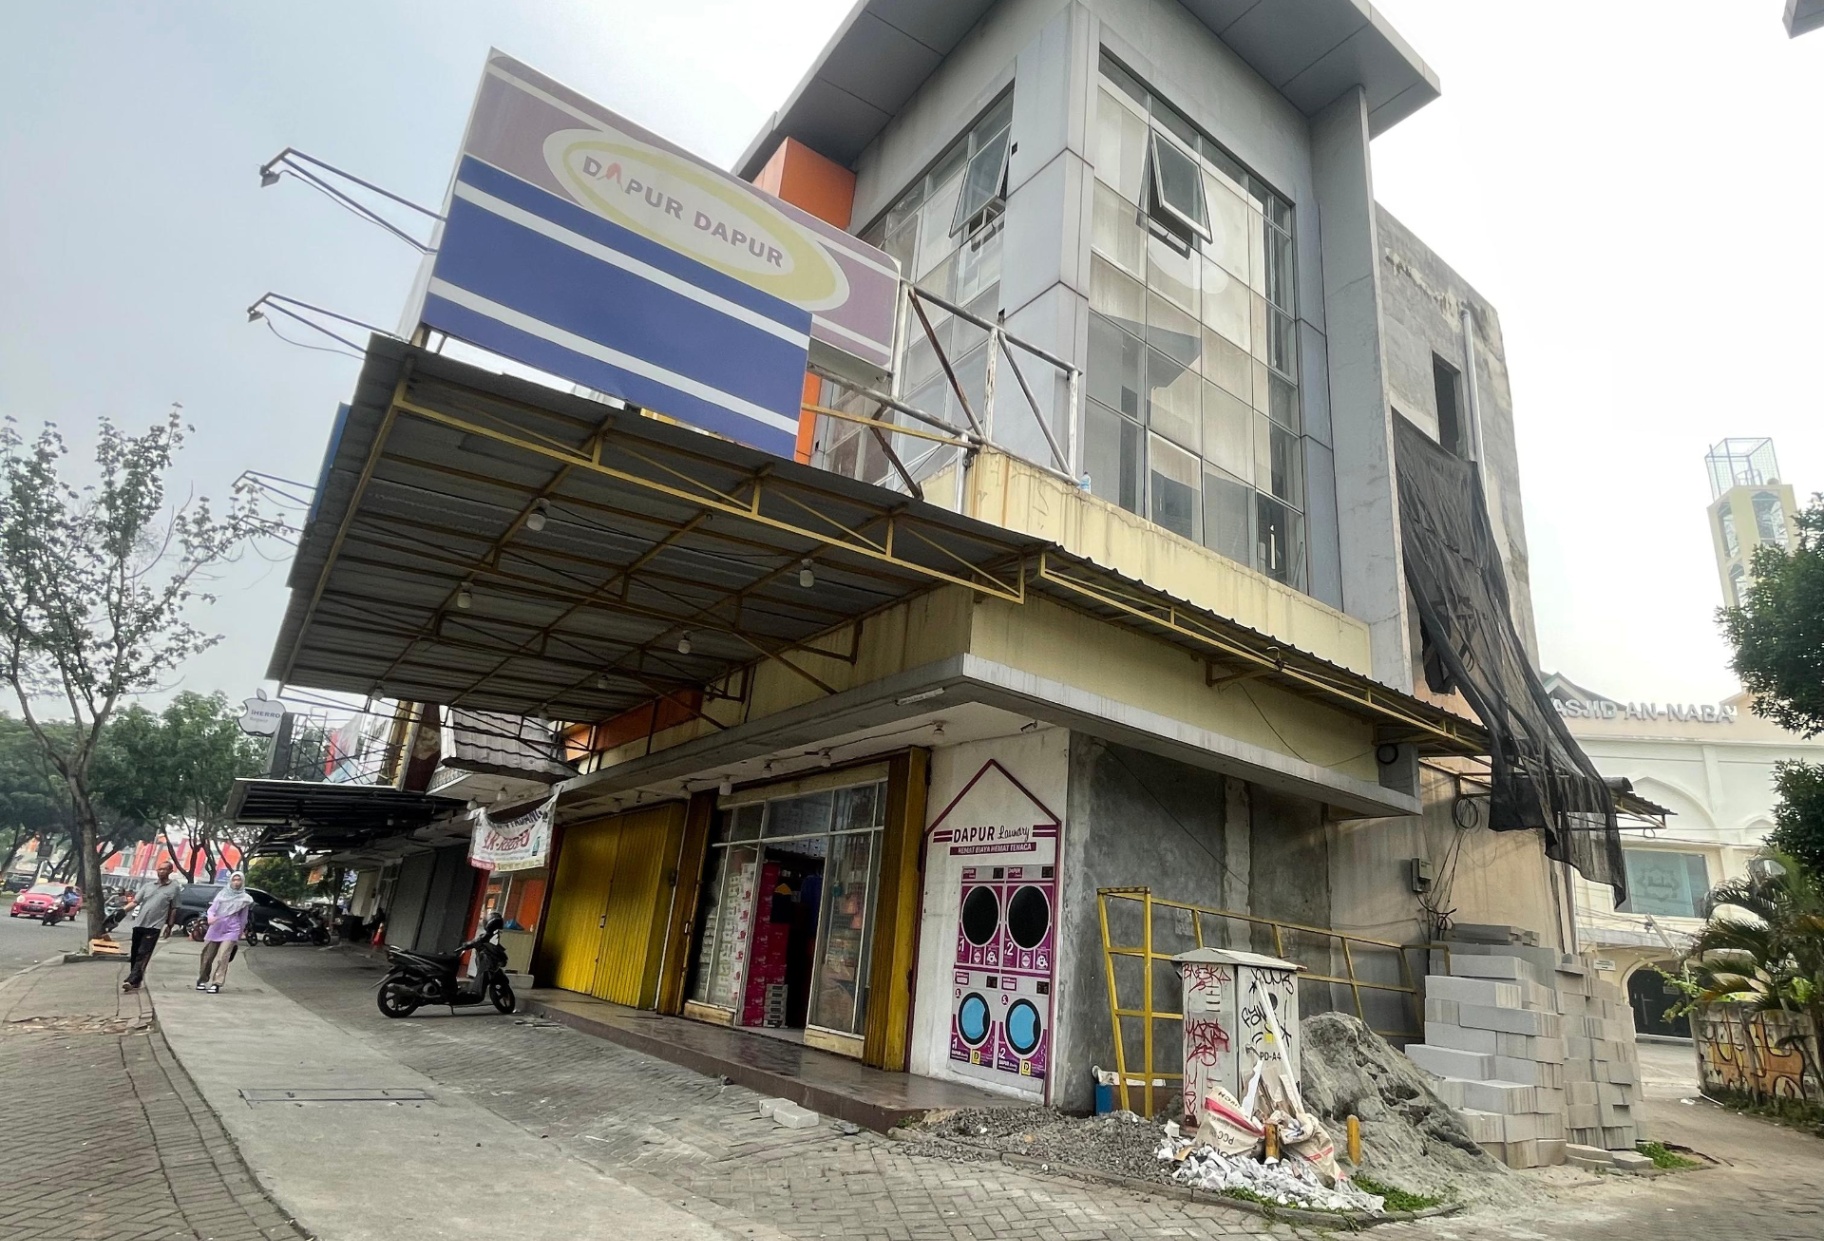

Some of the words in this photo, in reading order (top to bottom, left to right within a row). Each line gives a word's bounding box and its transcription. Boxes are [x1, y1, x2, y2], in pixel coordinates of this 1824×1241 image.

[582, 155, 684, 221] DAPUR
[693, 210, 784, 269] DAPUR
[1551, 697, 1618, 719] ASJID
[953, 826, 995, 843] DAPUR
